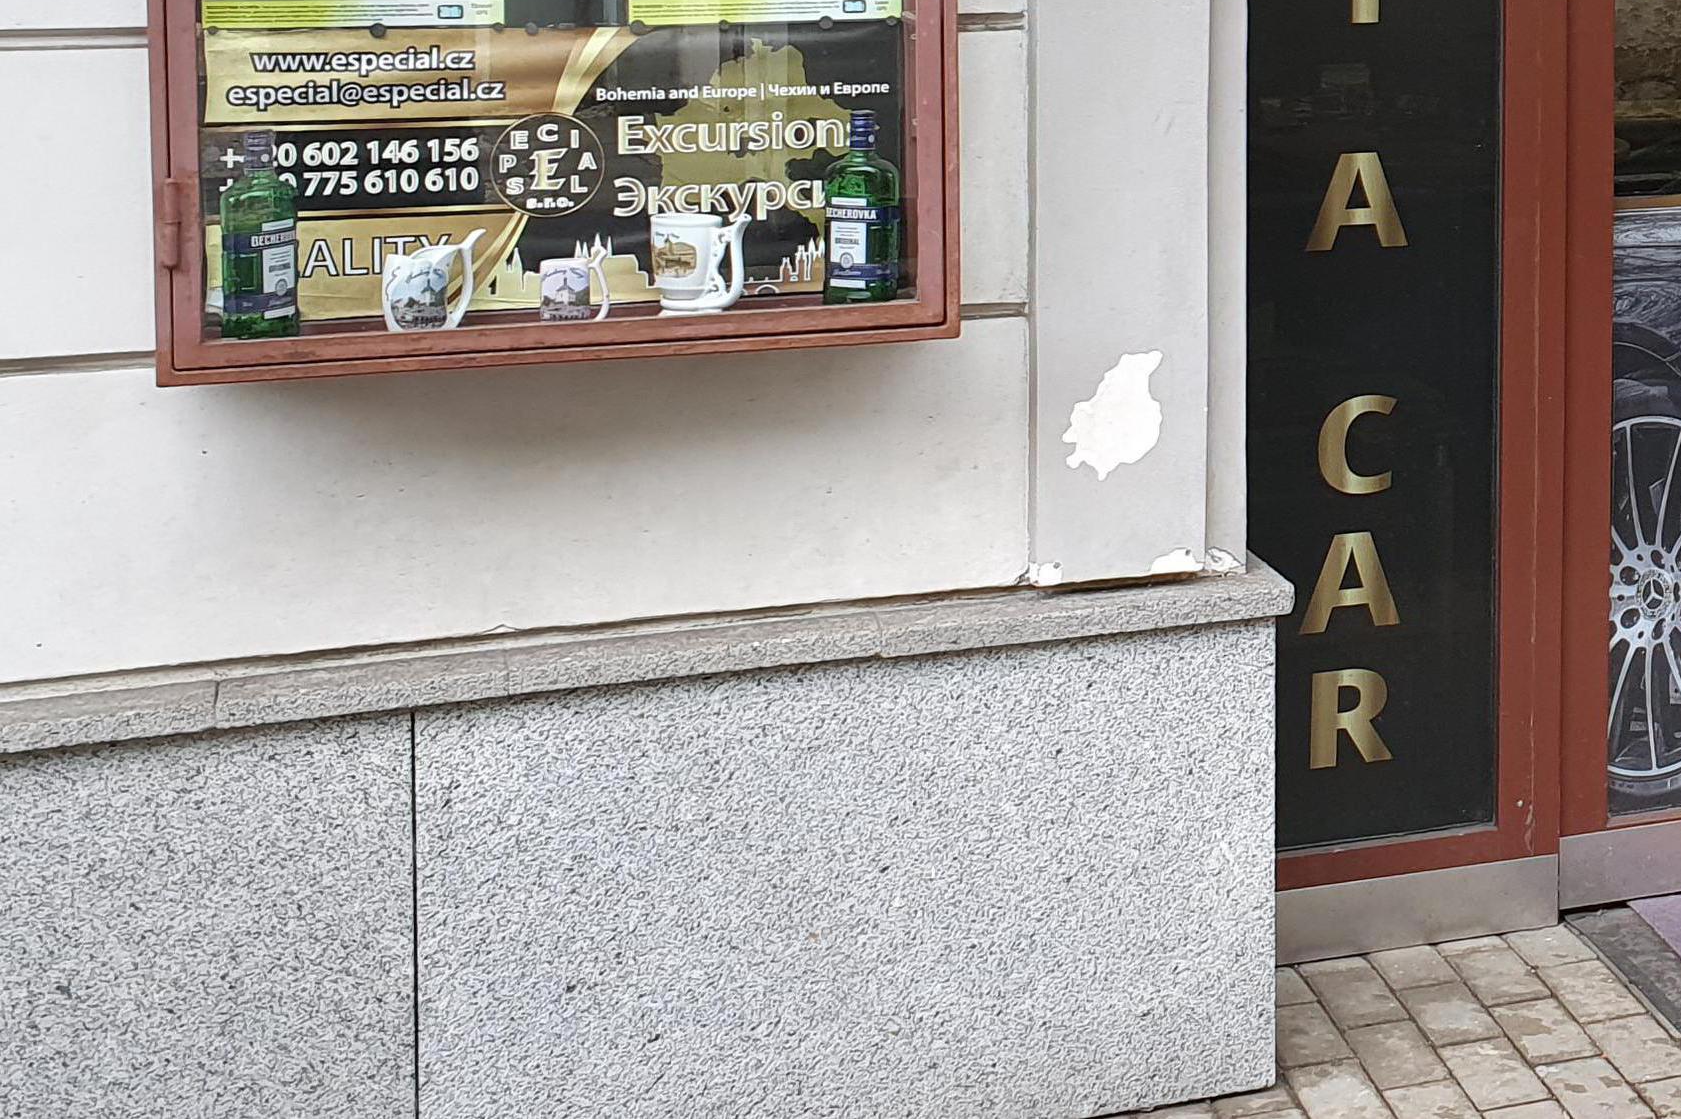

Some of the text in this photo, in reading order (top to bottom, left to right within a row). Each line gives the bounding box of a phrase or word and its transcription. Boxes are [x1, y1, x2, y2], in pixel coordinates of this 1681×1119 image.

[251, 44, 475, 76] www.especial.cz
[227, 79, 506, 110] especial@especial.cz
[595, 85, 666, 102] Bohemia
[669, 86, 699, 100] and
[702, 85, 757, 101] Europe
[769, 80, 890, 97] Чехии и Европе
[302, 141, 359, 168] 602
[366, 139, 419, 166] 146
[427, 137, 480, 163] 156
[303, 171, 358, 197] 775
[363, 169, 419, 195] 610
[424, 166, 480, 193] 610
[1304, 152, 1408, 251] A
[1300, 394, 1400, 769] CAR
